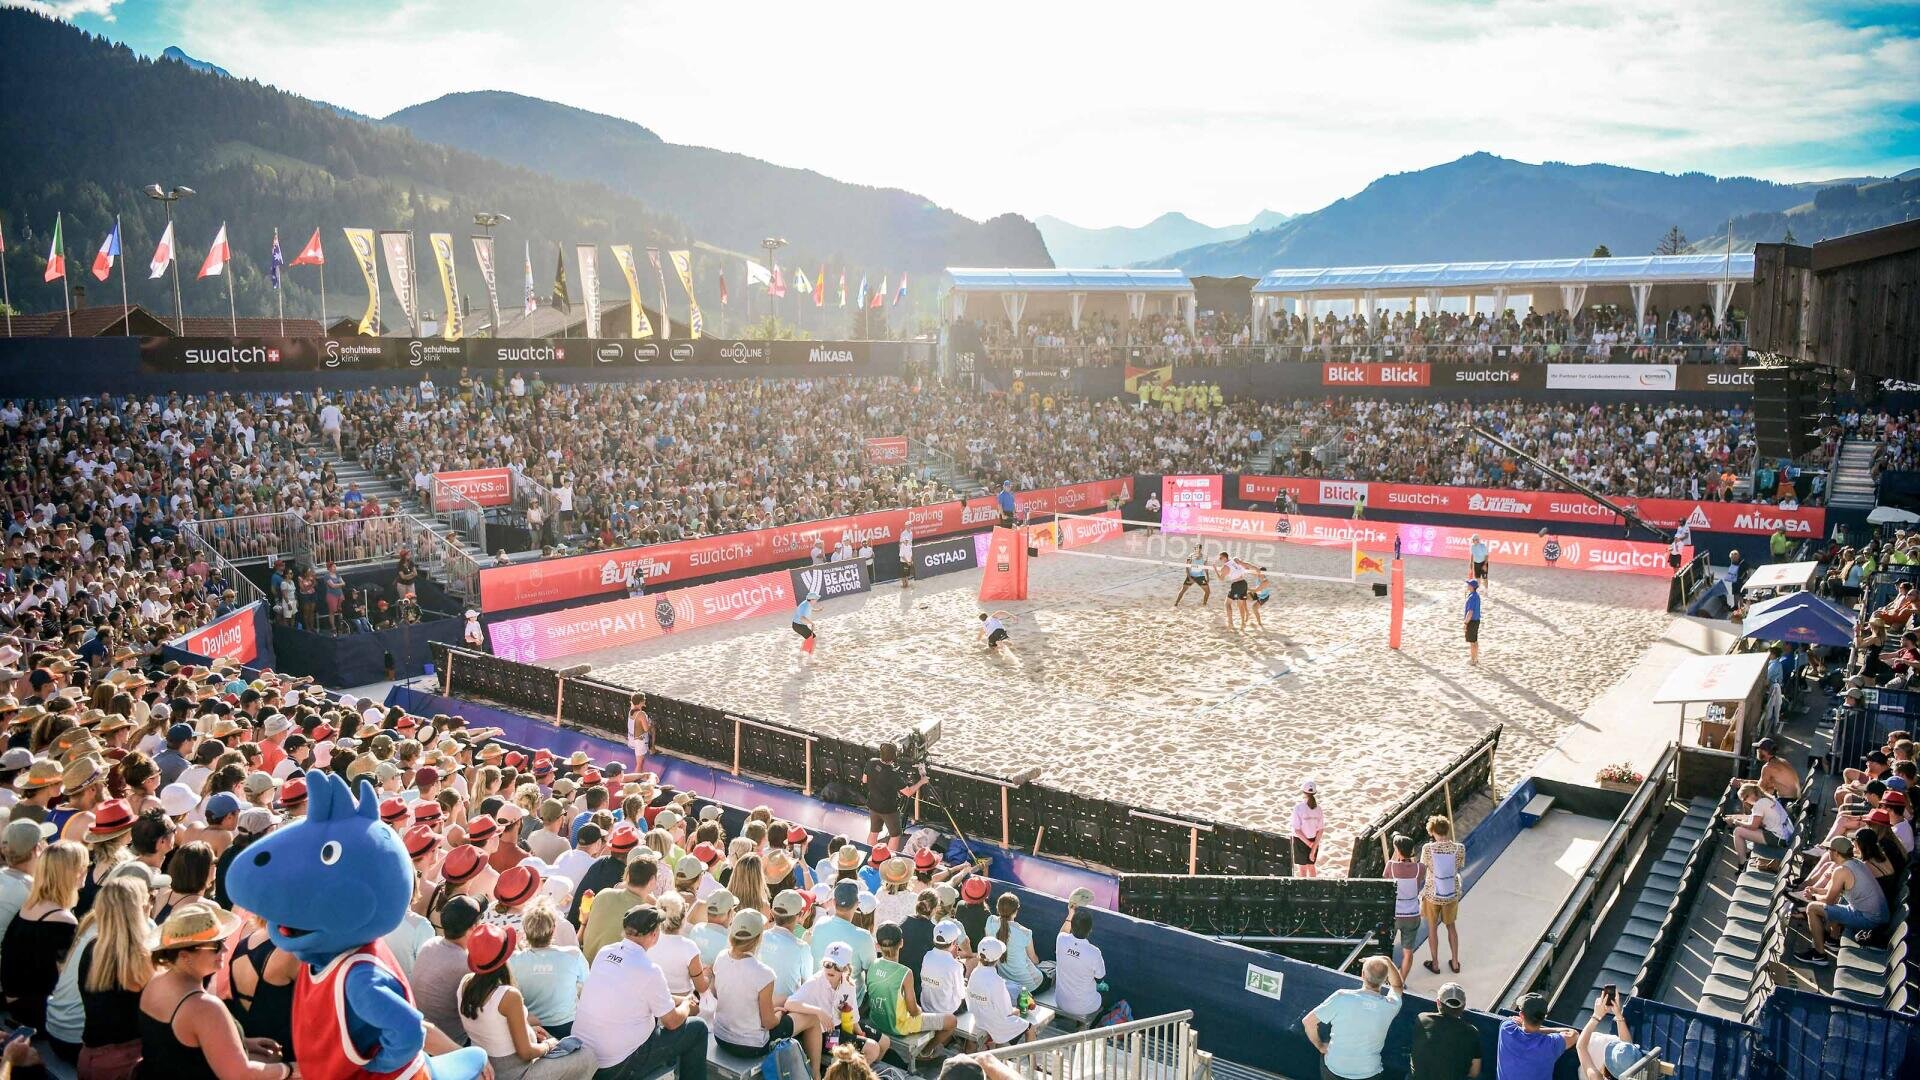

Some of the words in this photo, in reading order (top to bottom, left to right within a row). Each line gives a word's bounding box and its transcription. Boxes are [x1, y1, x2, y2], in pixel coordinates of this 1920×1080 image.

[185, 346, 266, 363] swatch
[340, 345, 381, 355] schulthess
[423, 345, 460, 355] schulthess
[497, 345, 556, 361] swatch
[341, 354, 360, 363] klinik
[423, 354, 440, 362] klinik
[1328, 367, 1364, 382] Blick
[1381, 367, 1418, 382] Blick
[1456, 370, 1510, 382] swatch
[1323, 485, 1359, 501] Blick
[1468, 501, 1532, 514] BULLETIN
[909, 509, 943, 524] Daylong
[1733, 513, 1811, 533] MIKASA
[1231, 520, 1264, 532] PAY!
[1488, 540, 1529, 556] PAY!
[620, 560, 636, 568] THE
[925, 549, 966, 567] GSTAAD
[824, 569, 859, 586] BEACH
[826, 583, 842, 595] PRO
[841, 580, 861, 591] TOUR
[547, 622, 598, 638] SWATCH
[598, 611, 645, 635] PAY!
[201, 625, 242, 656] Daylong
